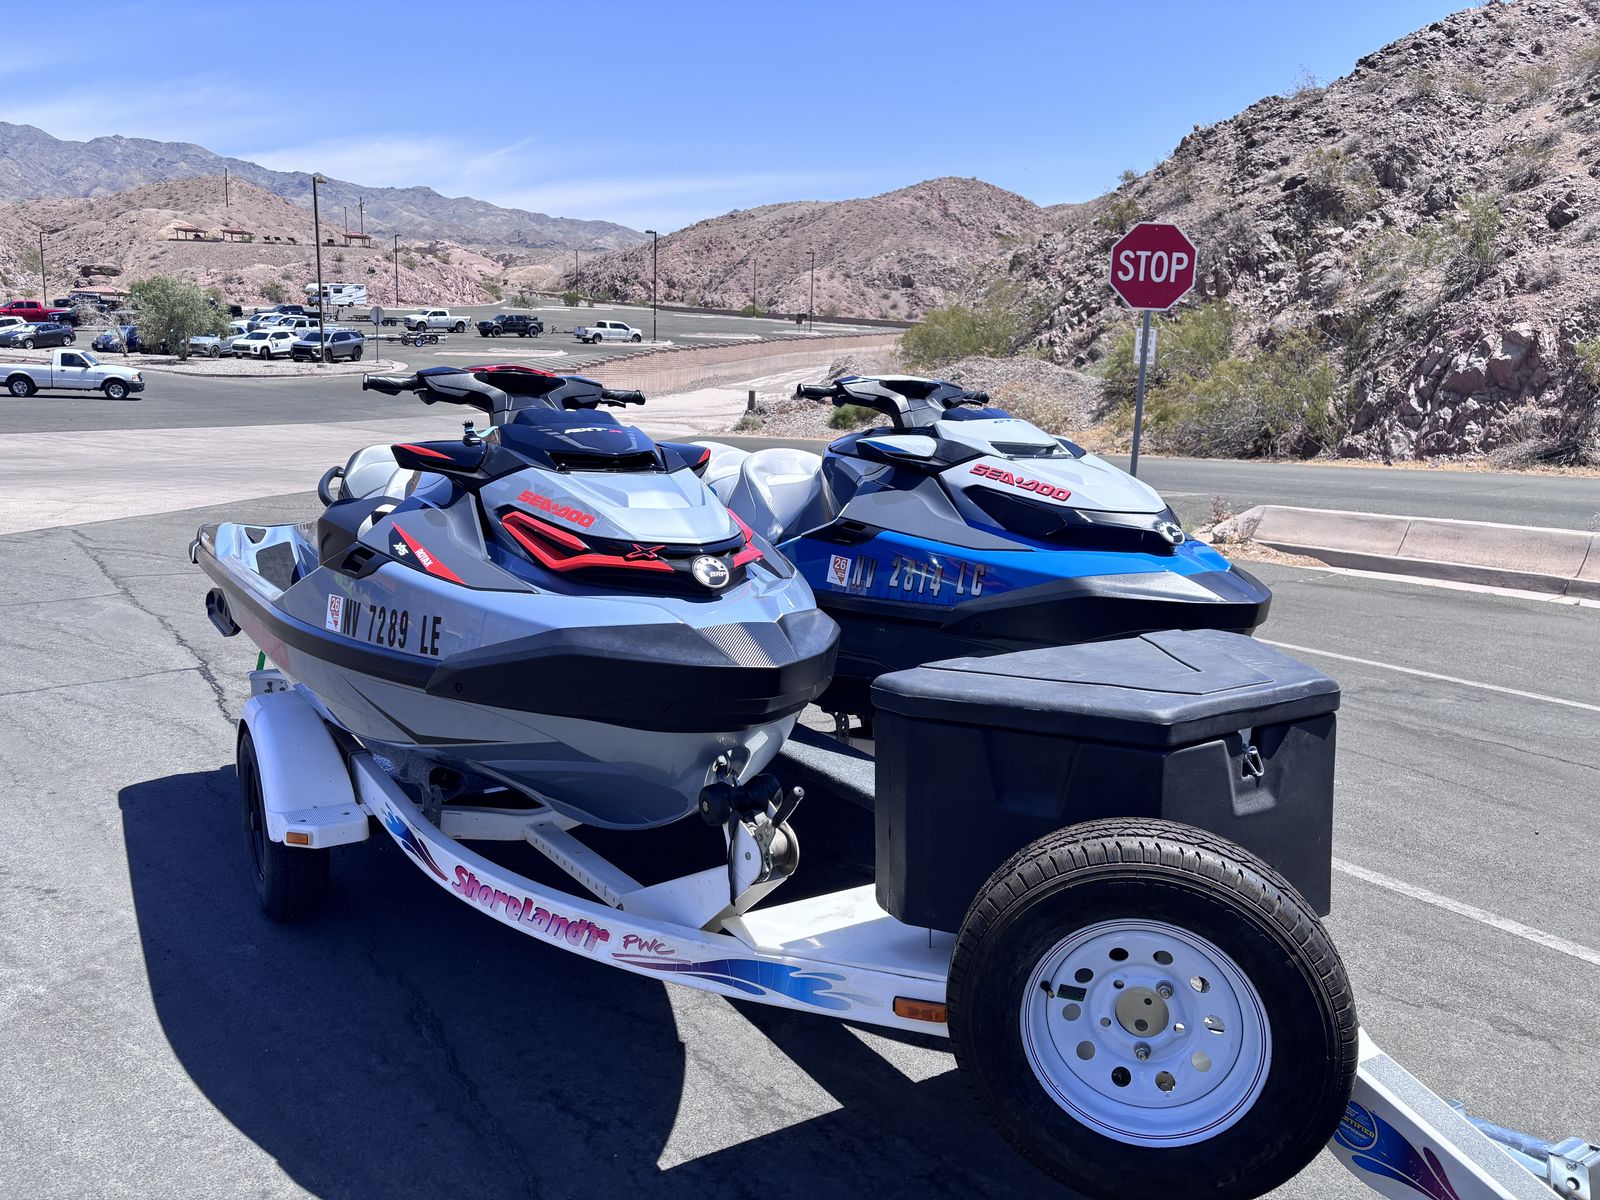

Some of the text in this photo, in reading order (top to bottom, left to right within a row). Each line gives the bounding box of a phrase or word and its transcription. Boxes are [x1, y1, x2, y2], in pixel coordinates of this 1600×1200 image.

[1117, 249, 1189, 283] STOP
[415, 548, 434, 568] ROTAX
[833, 557, 847, 570] 26
[852, 554, 878, 588] NV
[956, 561, 985, 596] LC
[330, 597, 340, 611] 26
[343, 598, 442, 656] NV 7289 LE
[622, 934, 675, 955] PWC
